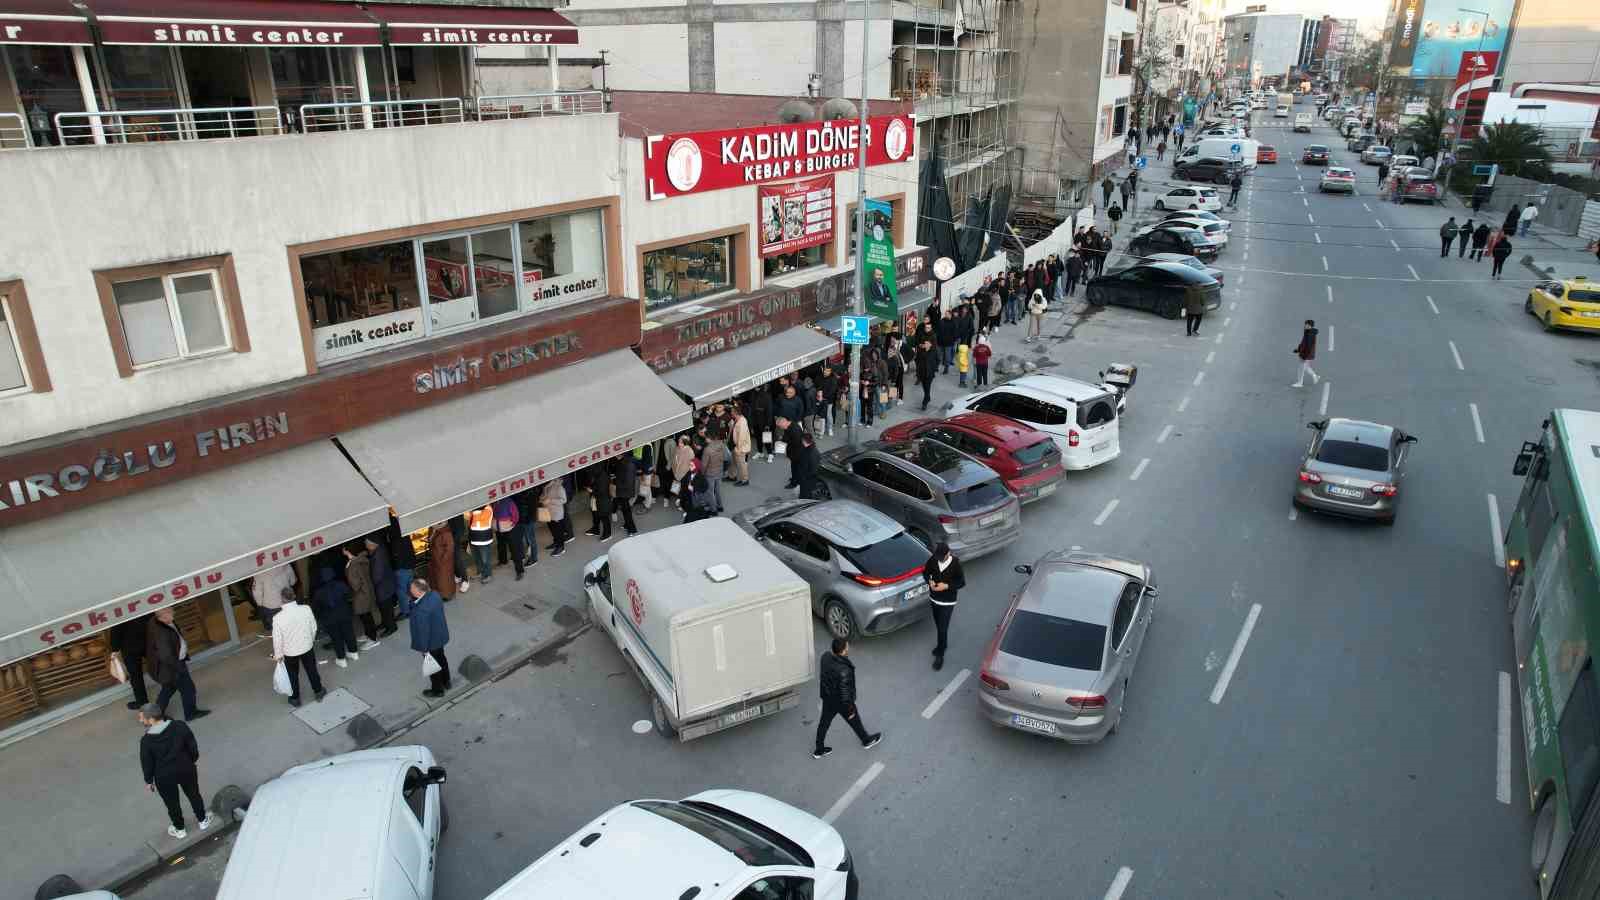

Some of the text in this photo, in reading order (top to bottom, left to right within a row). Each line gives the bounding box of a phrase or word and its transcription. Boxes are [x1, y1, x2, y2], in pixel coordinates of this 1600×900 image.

[153, 24, 344, 43] simit center
[422, 28, 553, 42] simit center
[744, 152, 855, 182] KEBAP & BURGER
[532, 277, 598, 301] simit center
[325, 319, 415, 350] simit center
[843, 318, 857, 337] P
[194, 411, 290, 457] FIRIN
[487, 438, 633, 500] simit center
